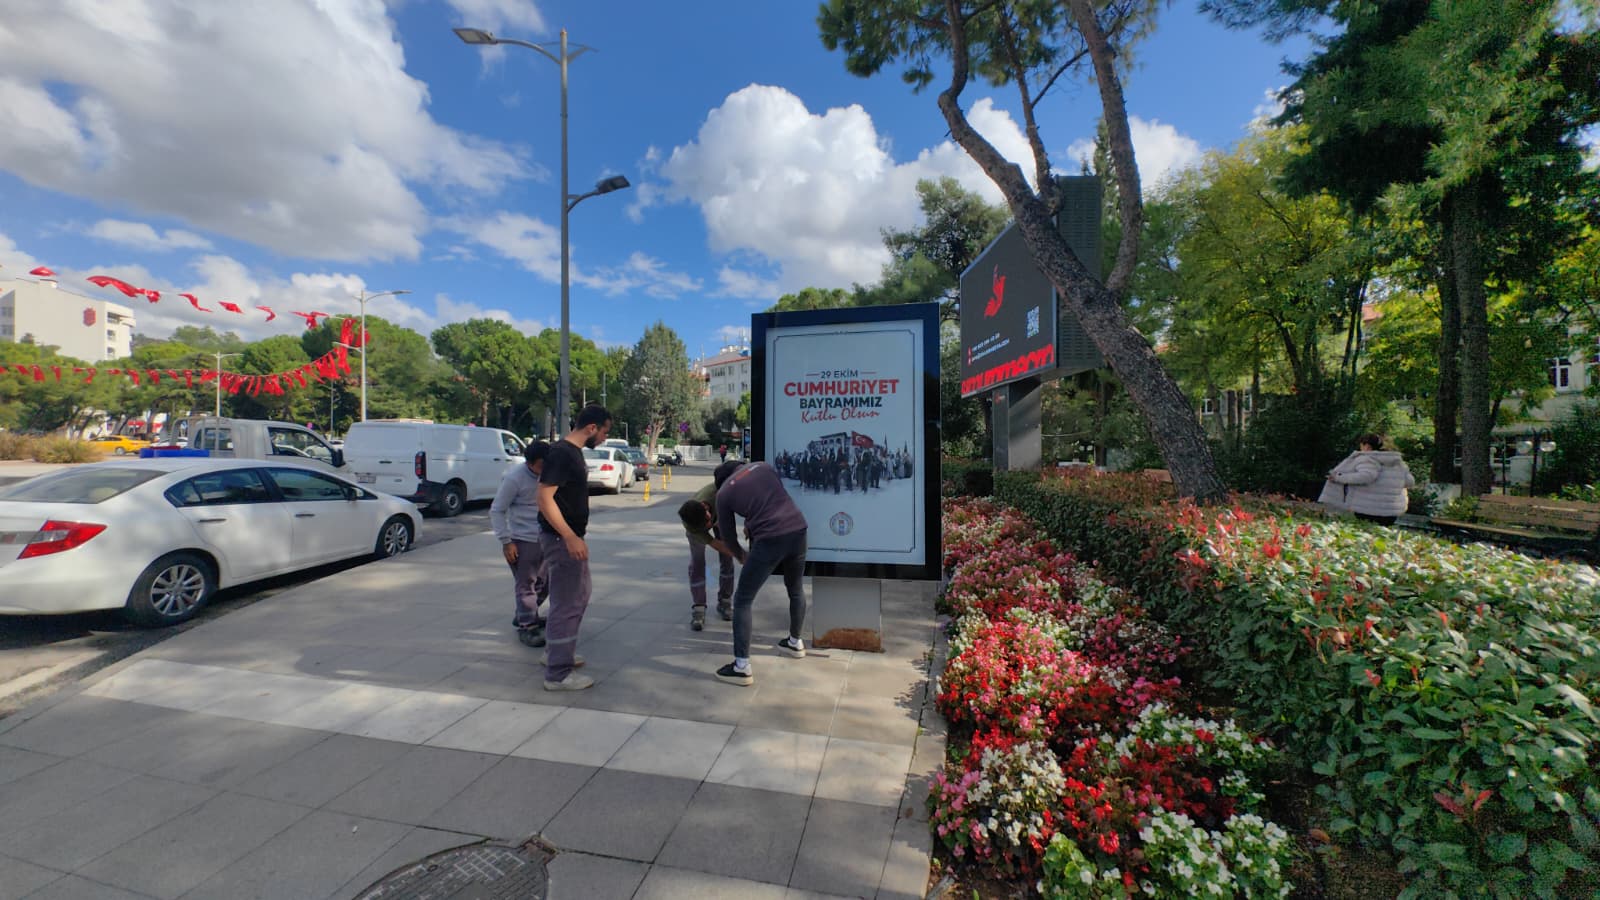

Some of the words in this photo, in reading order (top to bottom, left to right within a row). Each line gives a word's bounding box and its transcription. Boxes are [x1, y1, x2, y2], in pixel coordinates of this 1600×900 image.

[821, 370, 831, 379] 29
[834, 368, 858, 378] EKİM
[784, 379, 899, 396] CUMHURİYET
[800, 396, 883, 408] BAYRAMIMIZ
[801, 409, 837, 423] Kutlu
[841, 407, 880, 420] Olsun
